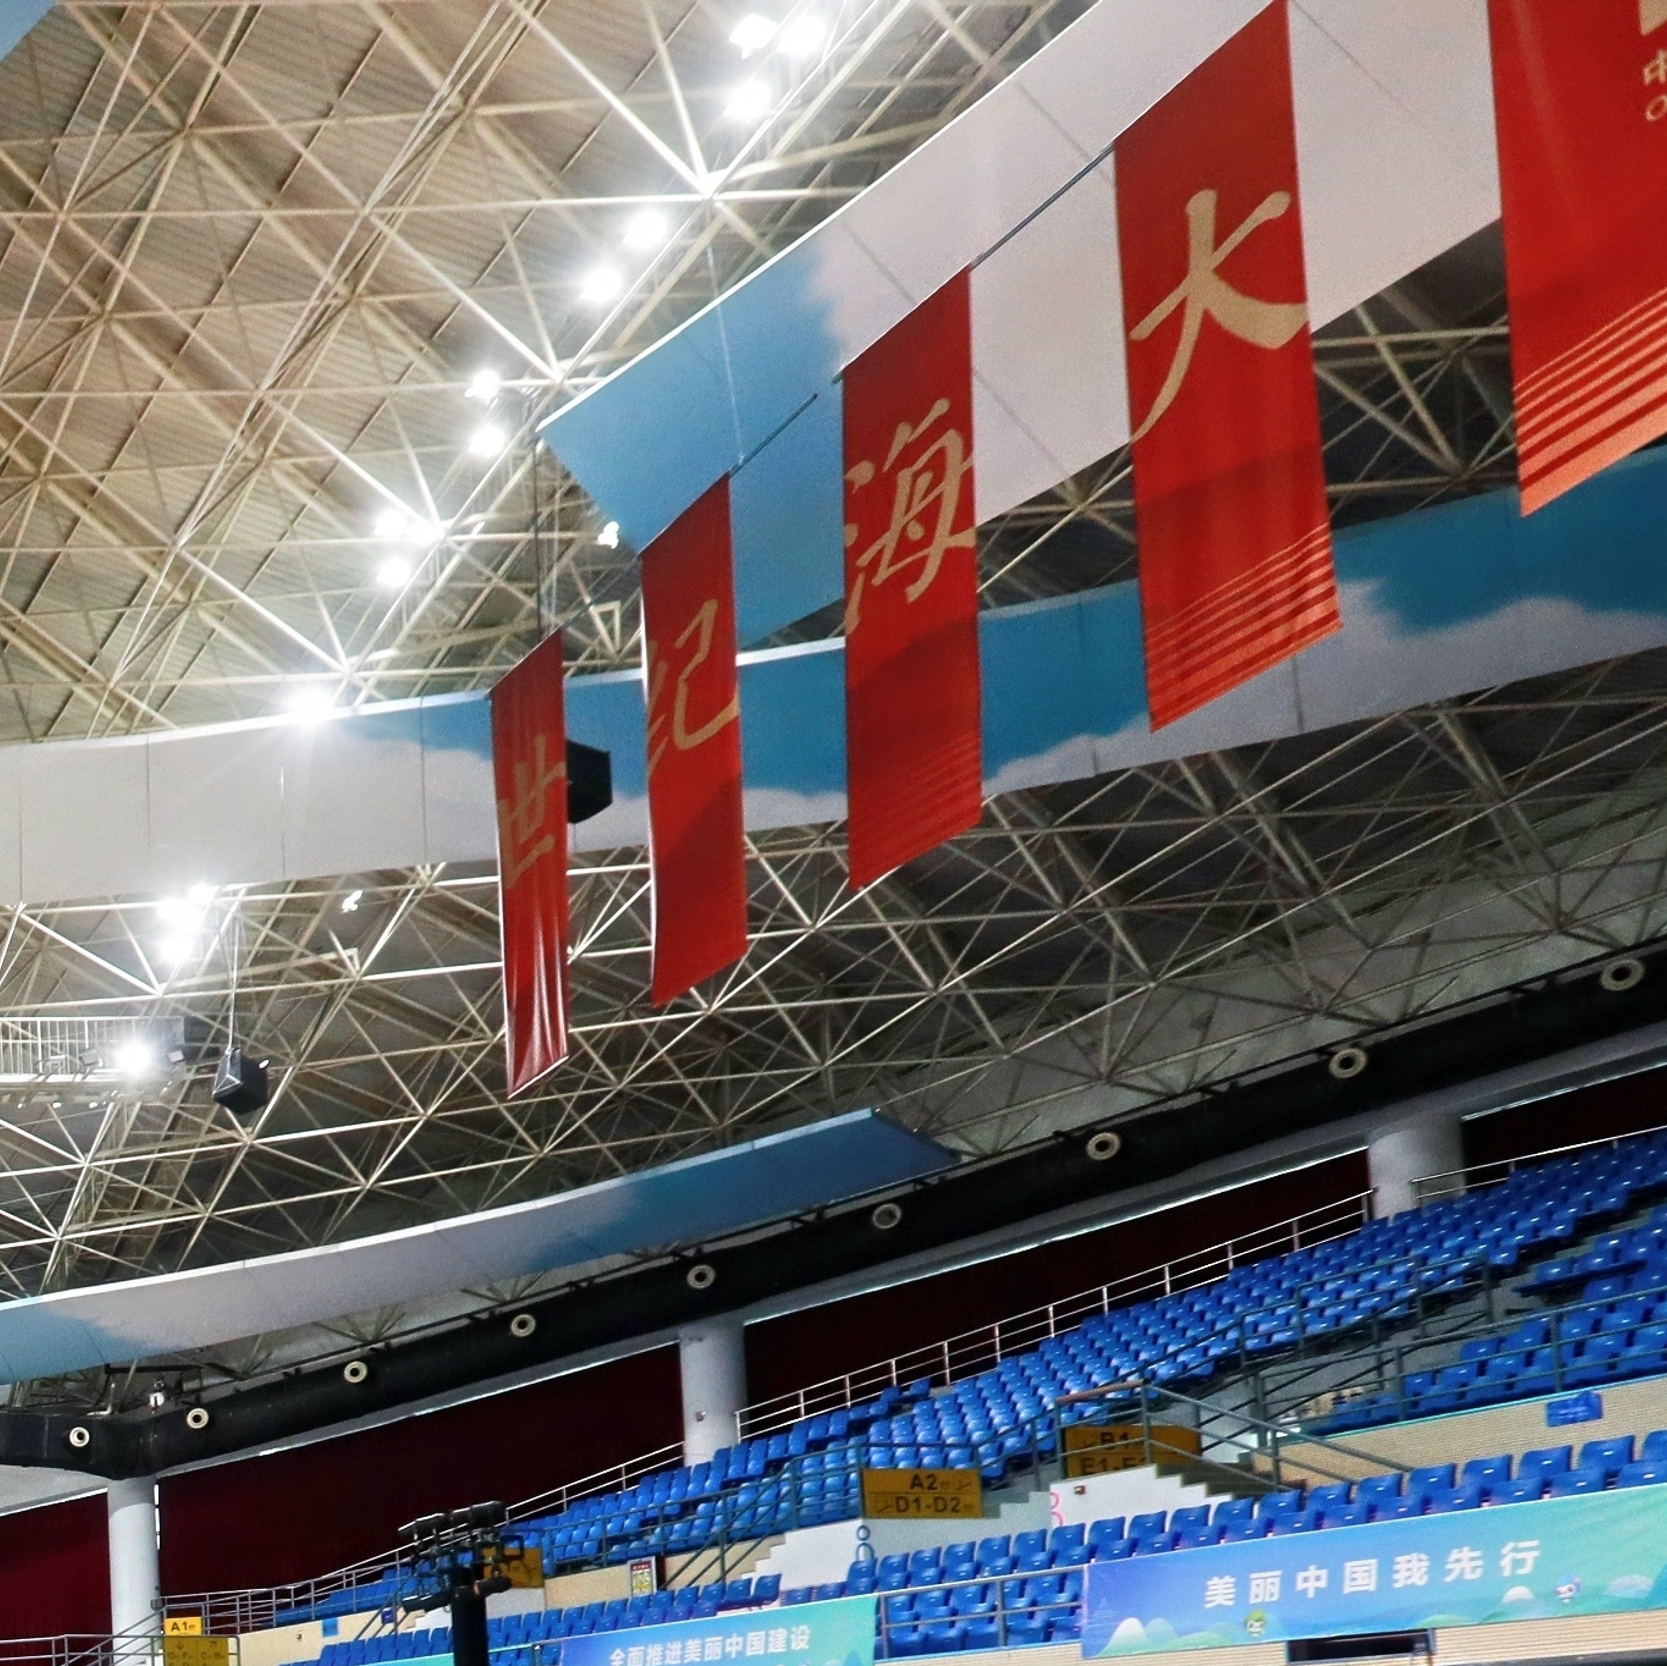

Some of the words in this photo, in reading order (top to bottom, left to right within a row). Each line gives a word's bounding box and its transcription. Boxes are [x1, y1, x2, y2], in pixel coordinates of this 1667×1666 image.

[1129, 188, 1308, 442] 大
[844, 398, 976, 637] 海
[909, 1475, 937, 1490] A2
[894, 1496, 961, 1513] D1-D2
[1204, 1540, 1540, 1609] 美丽中国我先行
[171, 1621, 188, 1632] A1
